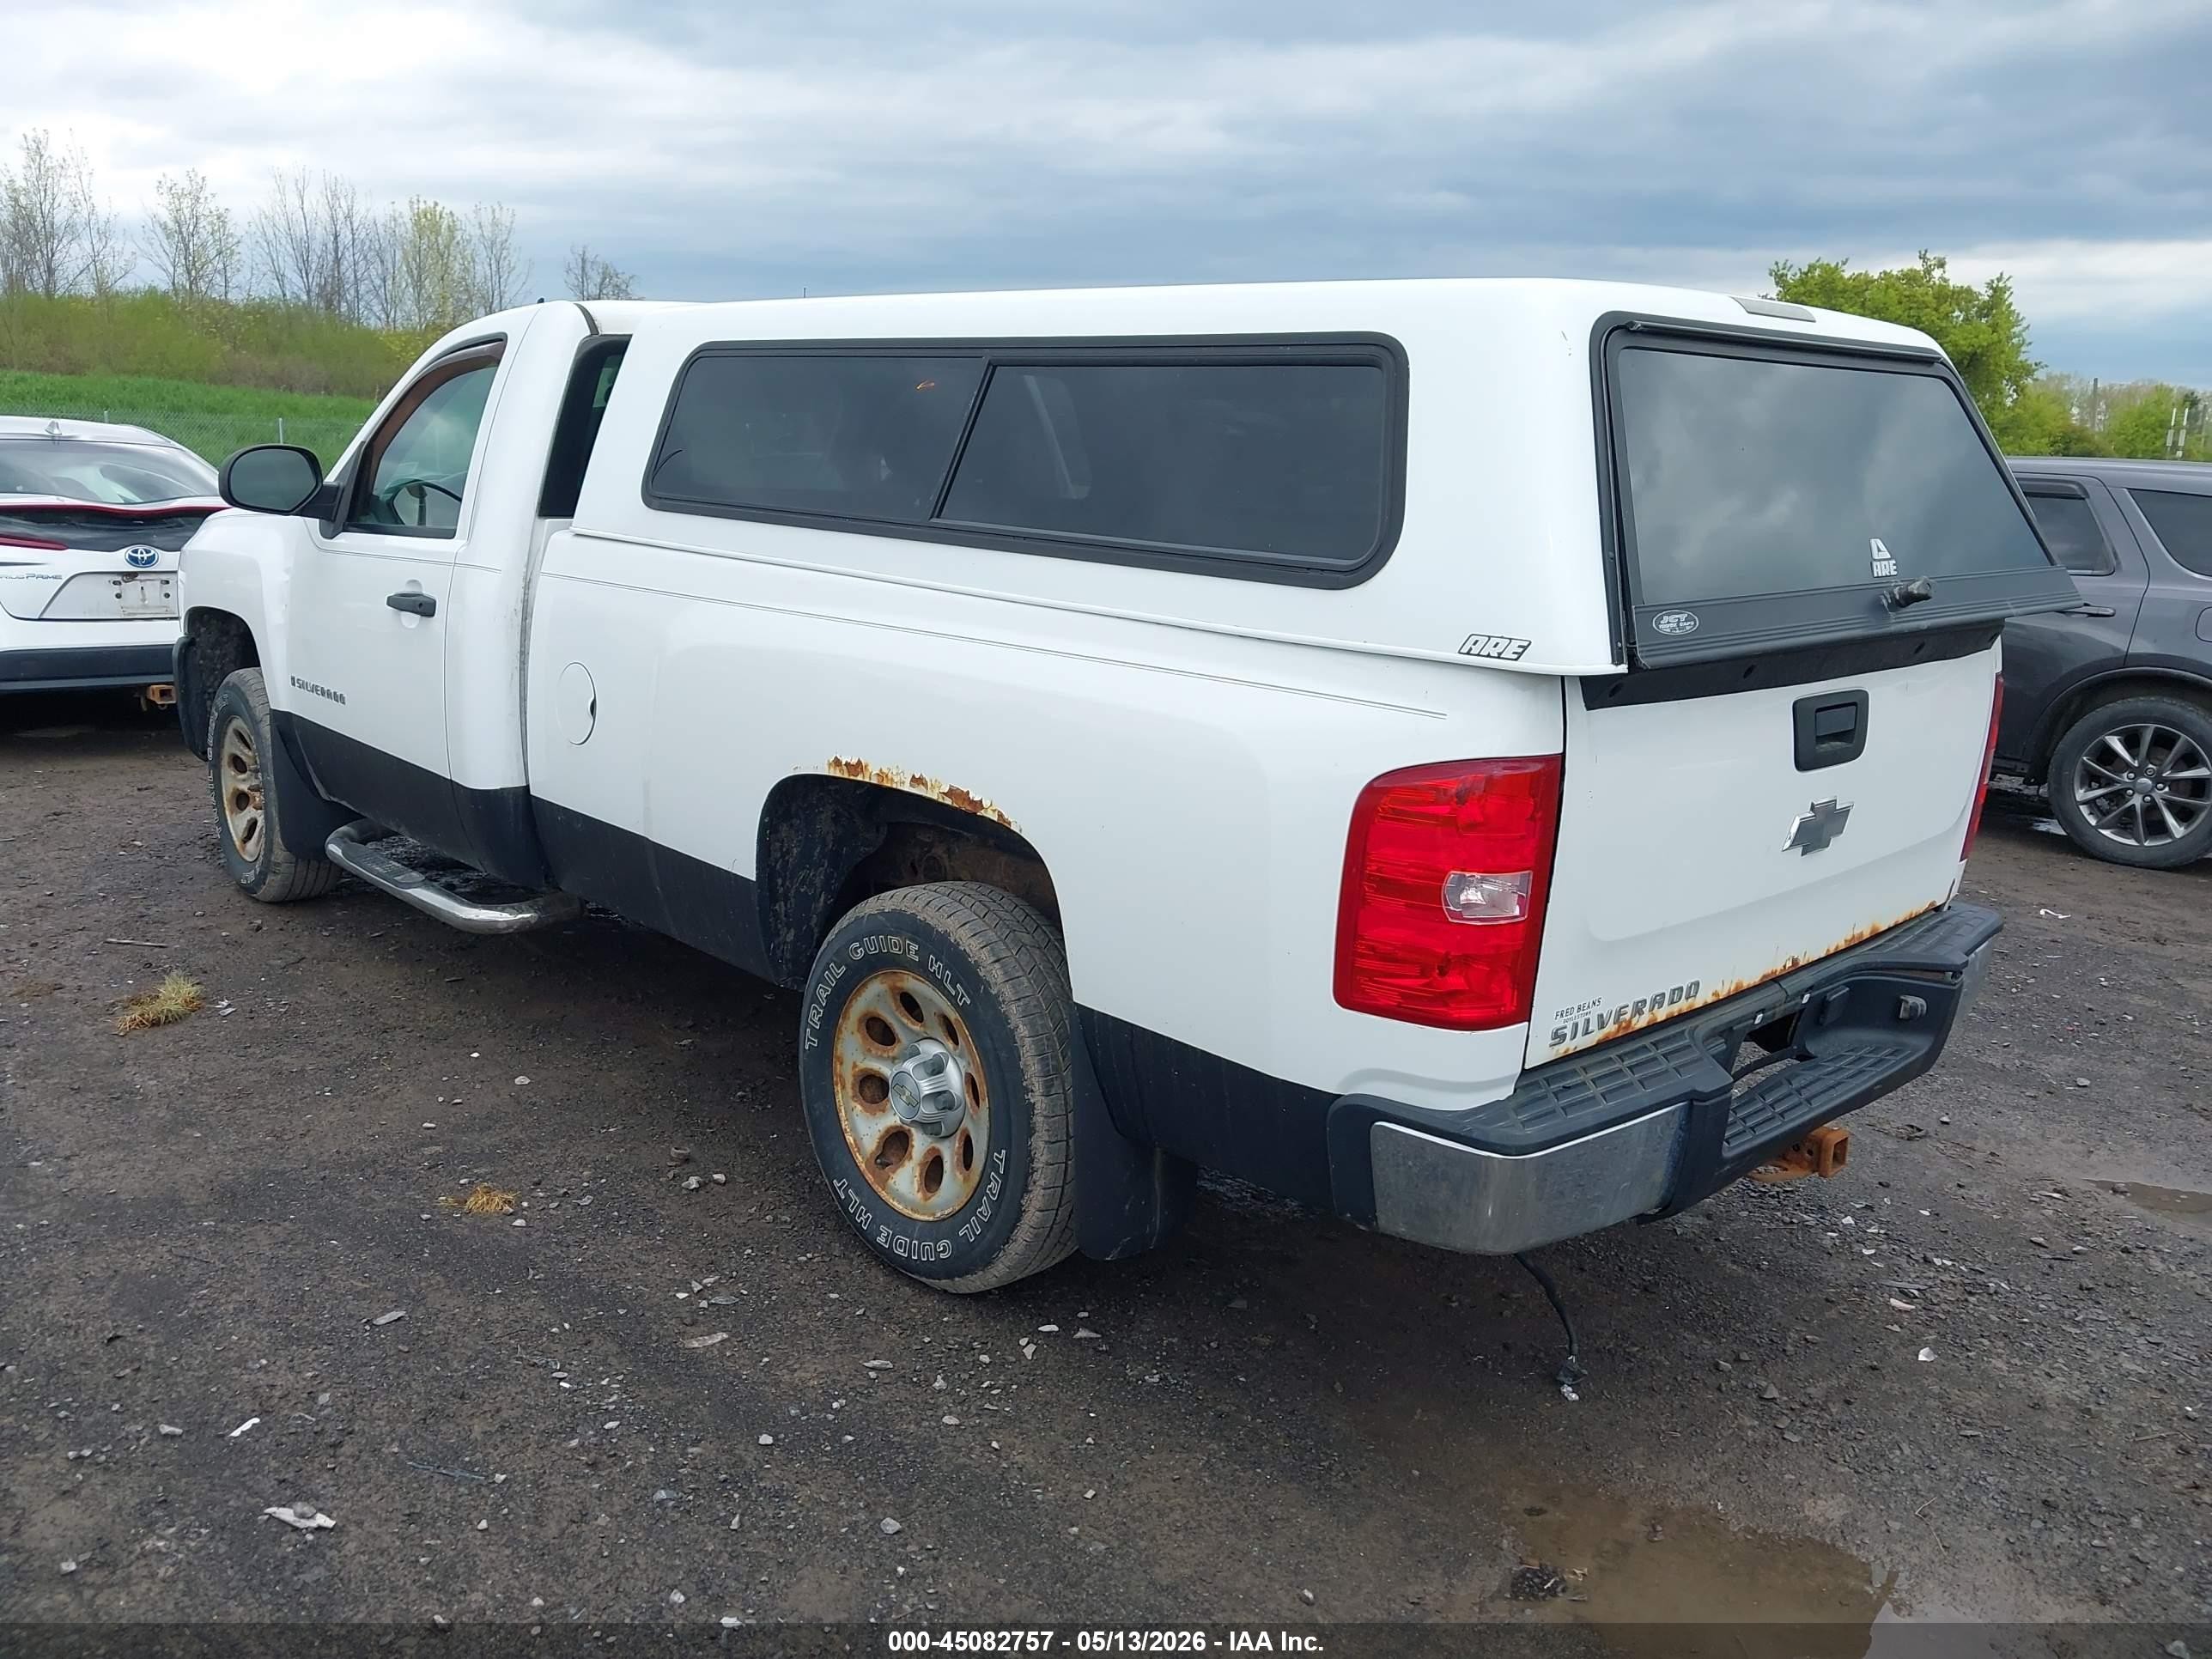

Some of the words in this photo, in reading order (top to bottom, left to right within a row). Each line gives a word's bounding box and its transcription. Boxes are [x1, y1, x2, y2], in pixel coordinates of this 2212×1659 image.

[1871, 560, 1898, 577] ARE
[1459, 634, 1532, 660] ARE
[805, 962, 847, 1050] TRAIL
[848, 935, 919, 962] GUIDE
[928, 955, 971, 1006] HLT
[1549, 980, 1700, 1047] SILVERADO
[1554, 1006, 1575, 1020] FRED
[1577, 997, 1602, 1014] BEANS
[833, 1178, 872, 1230] HLT
[958, 1149, 1006, 1243] TRAIL
[876, 1224, 952, 1261] GUIDE
